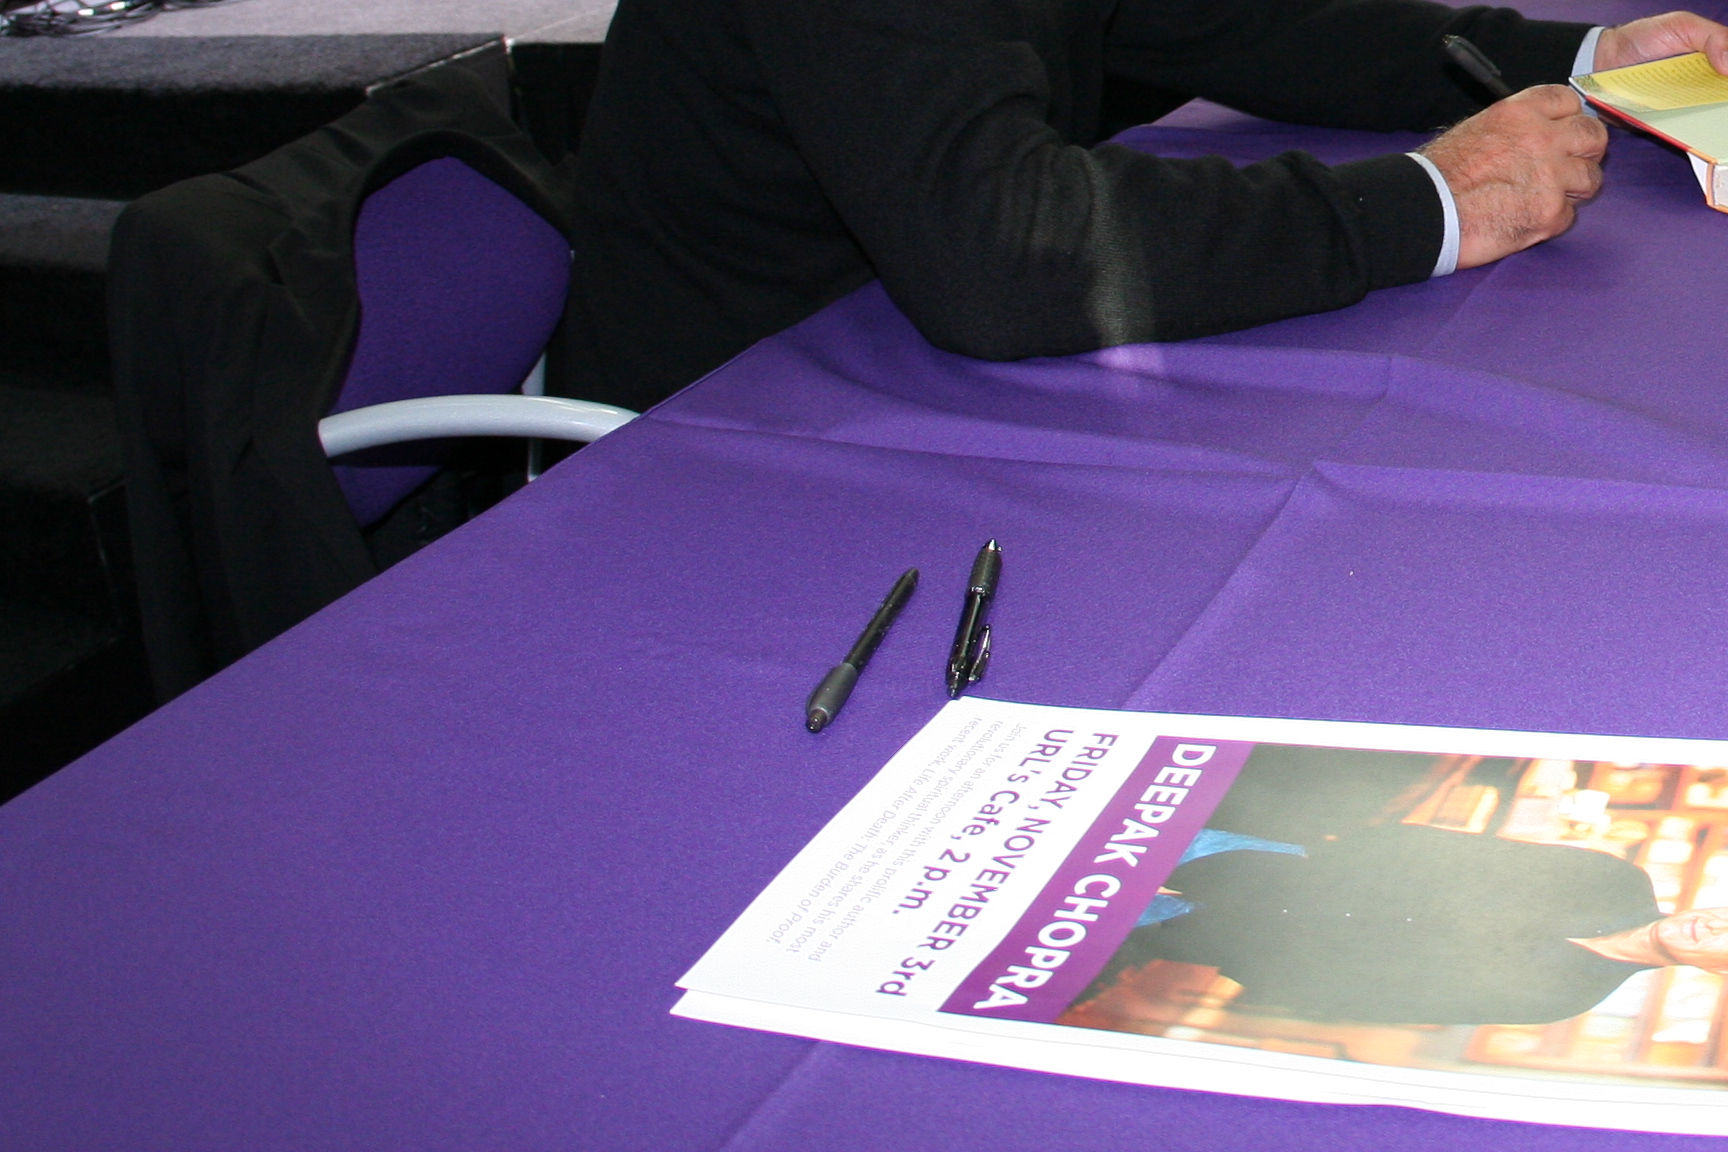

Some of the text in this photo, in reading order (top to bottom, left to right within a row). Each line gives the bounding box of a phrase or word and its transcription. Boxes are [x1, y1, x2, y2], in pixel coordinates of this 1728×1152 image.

[952, 717, 982, 744] recent
[948, 720, 1004, 775] revolutionary
[913, 767, 935, 786] Life
[892, 785, 917, 810] After
[916, 775, 953, 811] spiritual
[892, 728, 1074, 915] URL's Cafe, 2 p.m.
[808, 723, 1027, 962] Join us for an afternoon with this prolific author and
[843, 842, 868, 860] The
[872, 847, 888, 859] as
[858, 860, 880, 873] he
[875, 732, 1120, 997] FRIDAY, NOVEMBER 3rd
[973, 743, 1218, 1010] DEEPAK CHOPRA
[808, 861, 849, 897] Burden
[827, 874, 863, 907] shares
[797, 899, 812, 913] of
[812, 909, 836, 924] his
[785, 926, 816, 953] most
